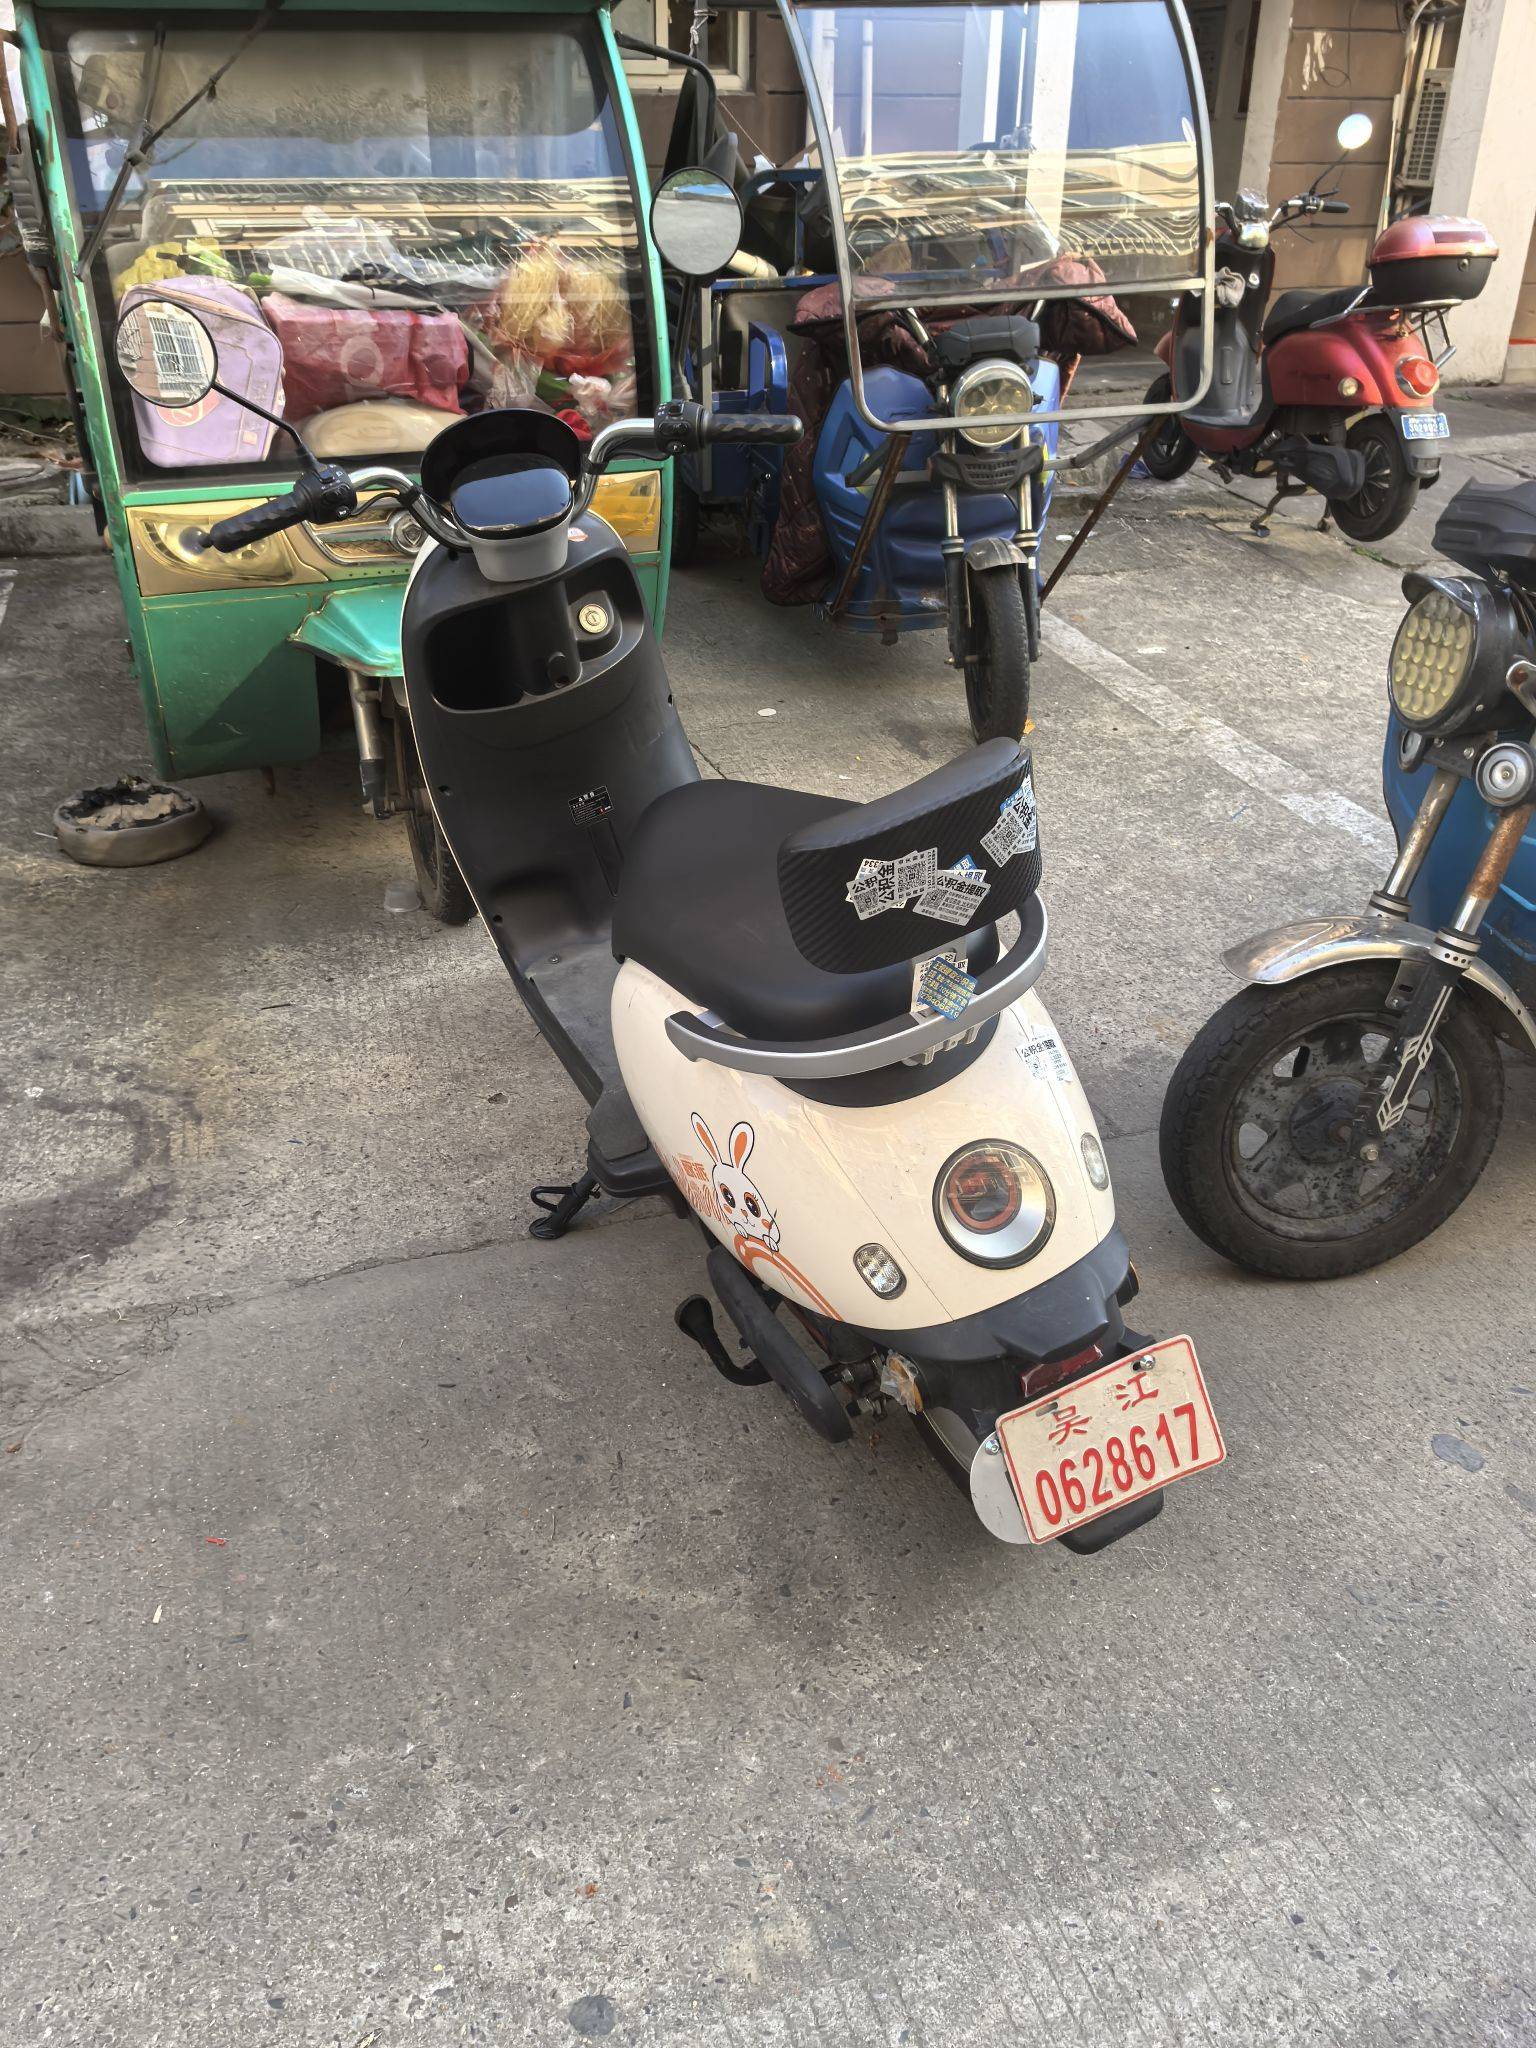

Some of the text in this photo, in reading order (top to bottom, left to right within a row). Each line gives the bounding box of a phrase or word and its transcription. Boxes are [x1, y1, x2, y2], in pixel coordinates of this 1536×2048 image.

[877, 862, 895, 903] 公积金
[936, 874, 987, 898] 公积金提取
[1035, 1402, 1200, 1525] 0628617
